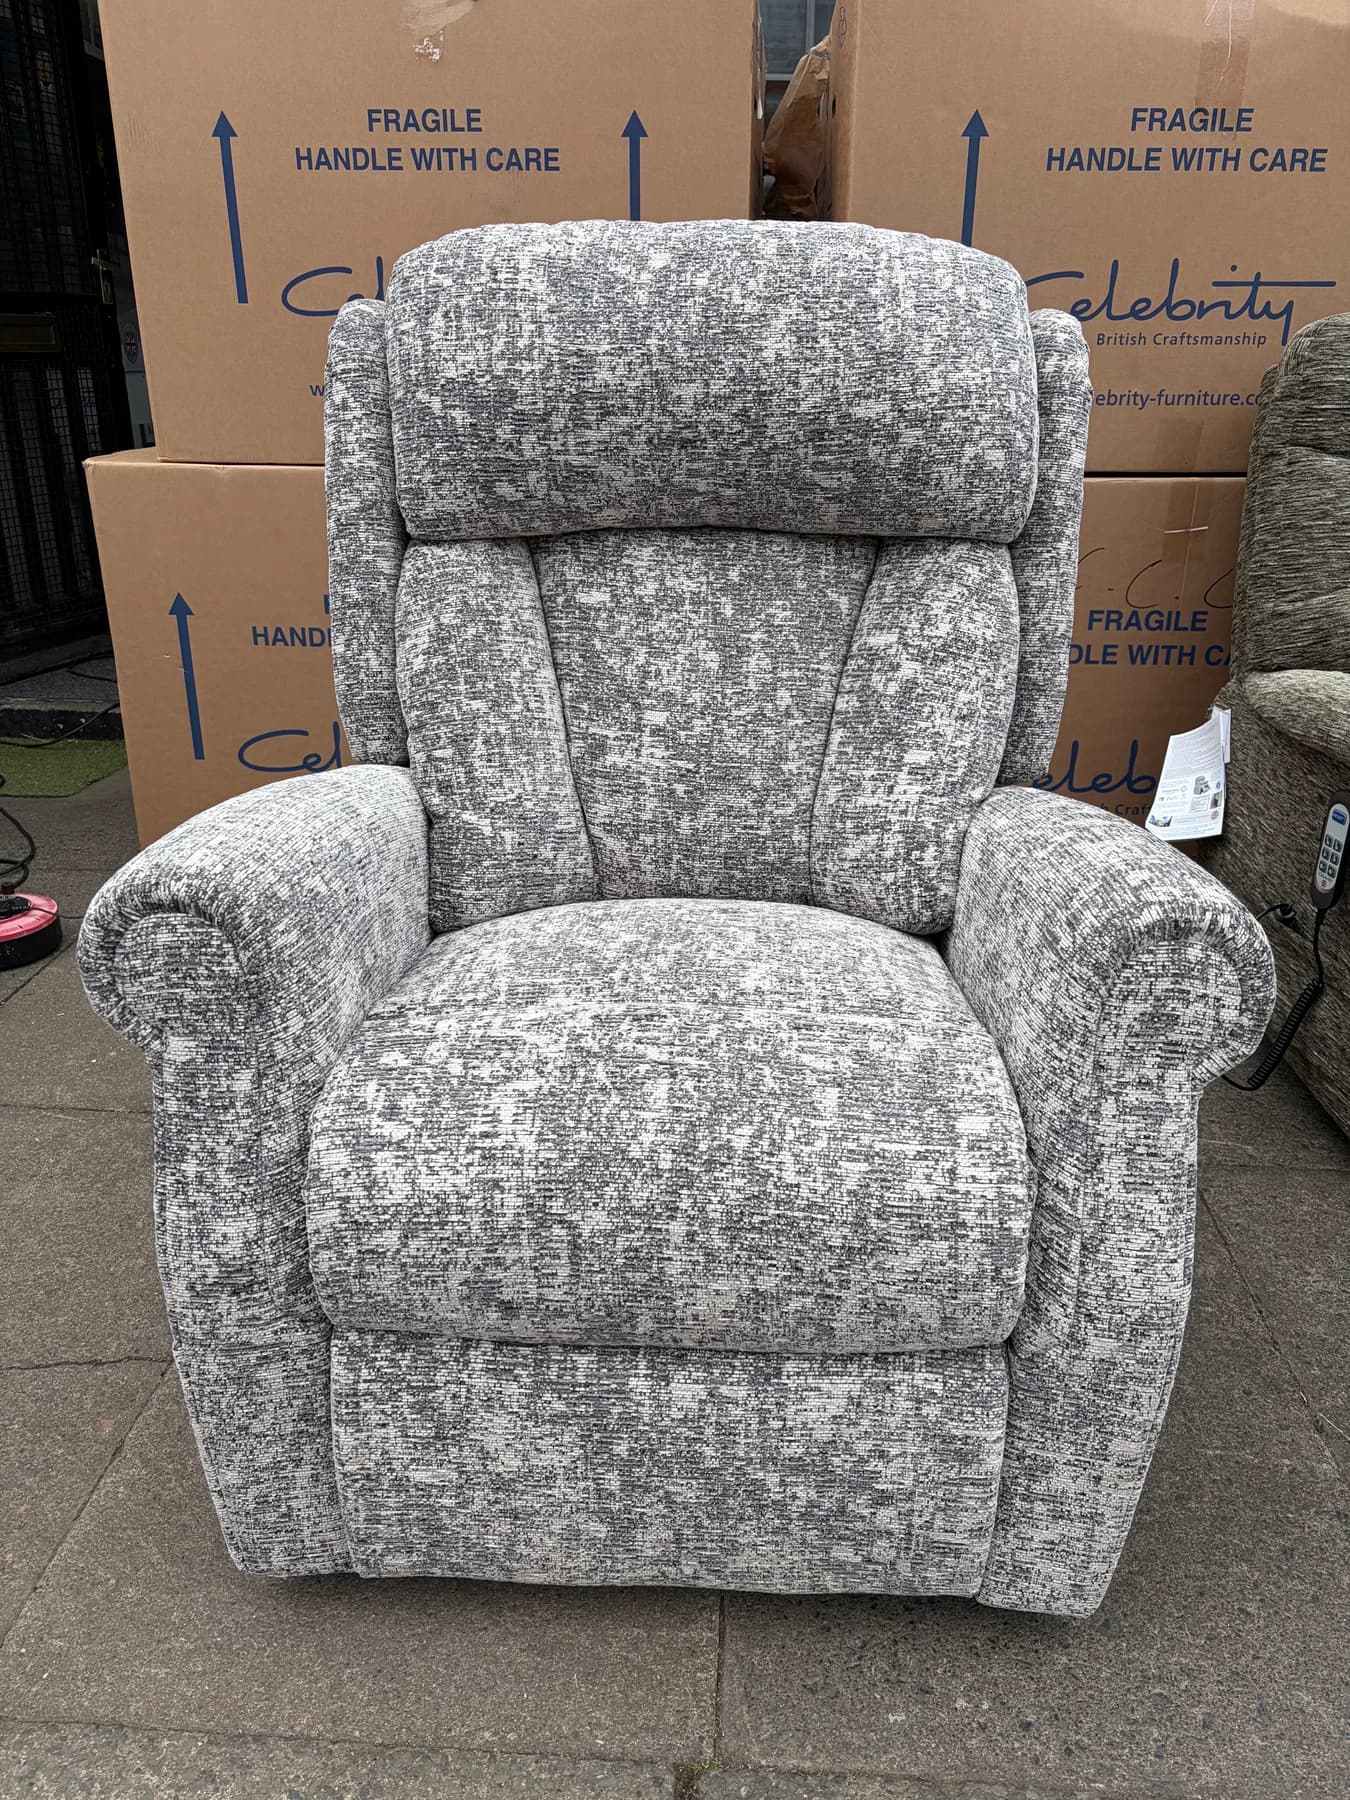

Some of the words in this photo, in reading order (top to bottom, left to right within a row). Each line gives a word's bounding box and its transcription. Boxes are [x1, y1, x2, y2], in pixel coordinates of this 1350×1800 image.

[367, 108, 483, 132] FRAGILE
[1130, 107, 1255, 132] FRAGILE
[295, 147, 404, 171] HANDLE
[411, 147, 477, 171] WITH
[485, 147, 561, 172] CARE
[1046, 147, 1162, 172] HANDLE
[1171, 147, 1241, 172] WITH
[1249, 147, 1329, 172] CARE
[1096, 333, 1147, 346] British
[1152, 331, 1267, 348] Craftsmanship
[1095, 389, 1263, 410] ebrity-furniture.co
[1087, 609, 1209, 632] FRAGILE
[1127, 644, 1196, 666] WITH
